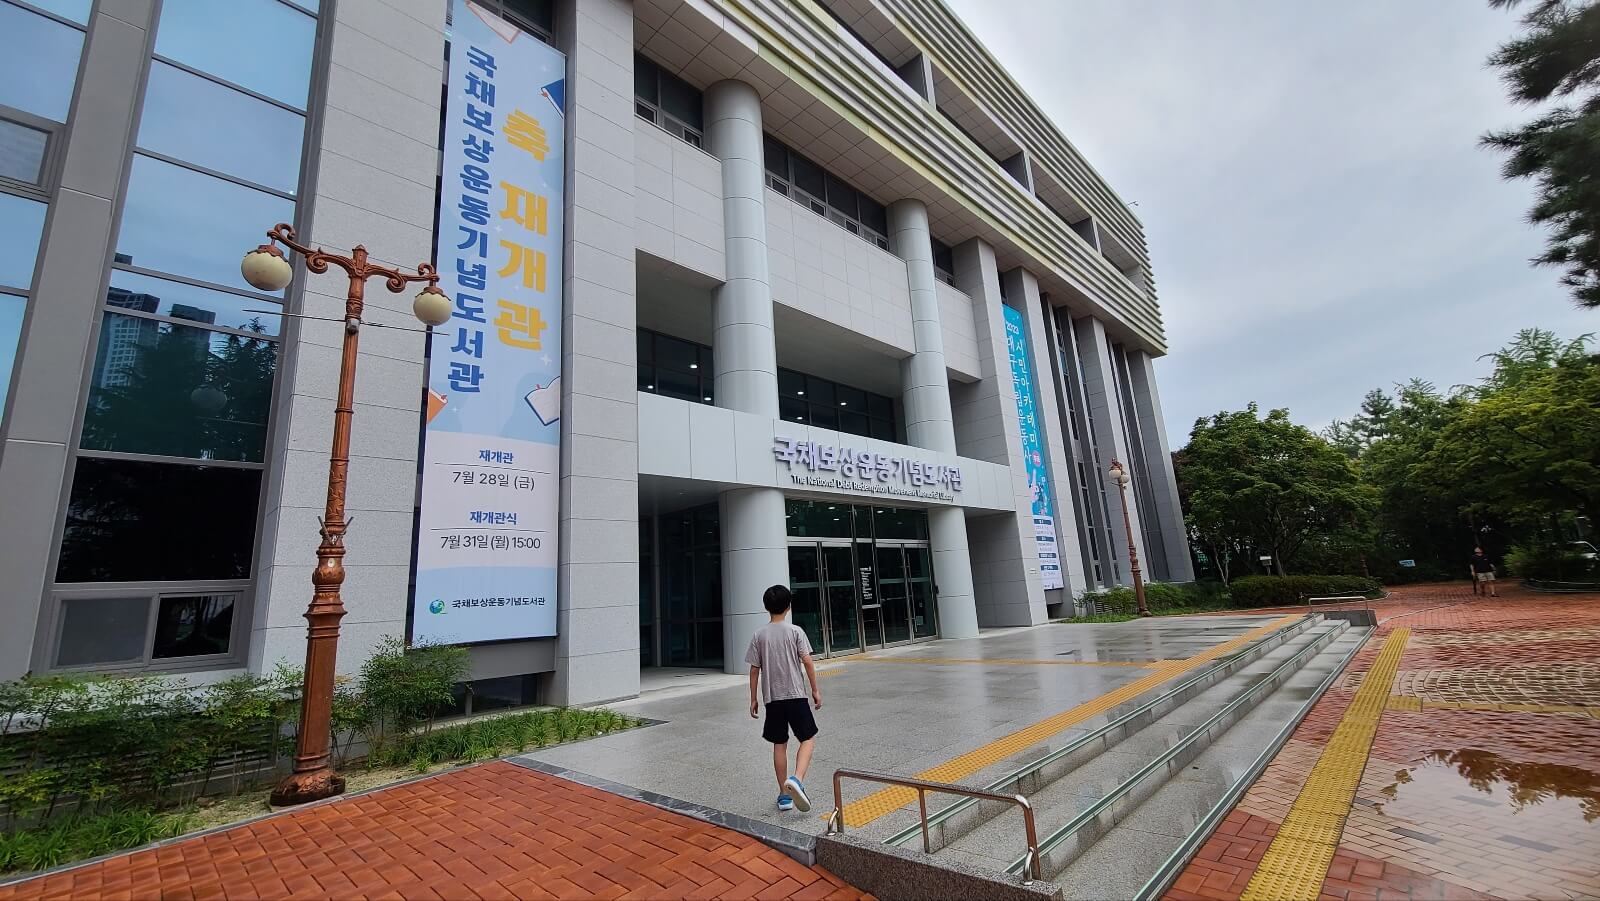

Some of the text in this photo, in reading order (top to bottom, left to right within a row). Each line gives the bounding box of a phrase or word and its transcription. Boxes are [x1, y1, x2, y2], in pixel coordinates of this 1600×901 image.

[447, 46, 497, 393] 국채보상운동기념도서관
[493, 108, 550, 351] 축 재개관
[479, 449, 514, 465] 재개관
[774, 436, 963, 492] 국채보상운동기념도서관
[453, 471, 535, 491] 7월 28일 (금)
[791, 474, 806, 485] The
[806, 476, 834, 488] National
[836, 480, 851, 490] Debt
[469, 511, 517, 525] 재개관식
[440, 535, 541, 550] 7월 31일 (월) 15:00
[452, 597, 545, 609] 국채보상운동기념도서관
